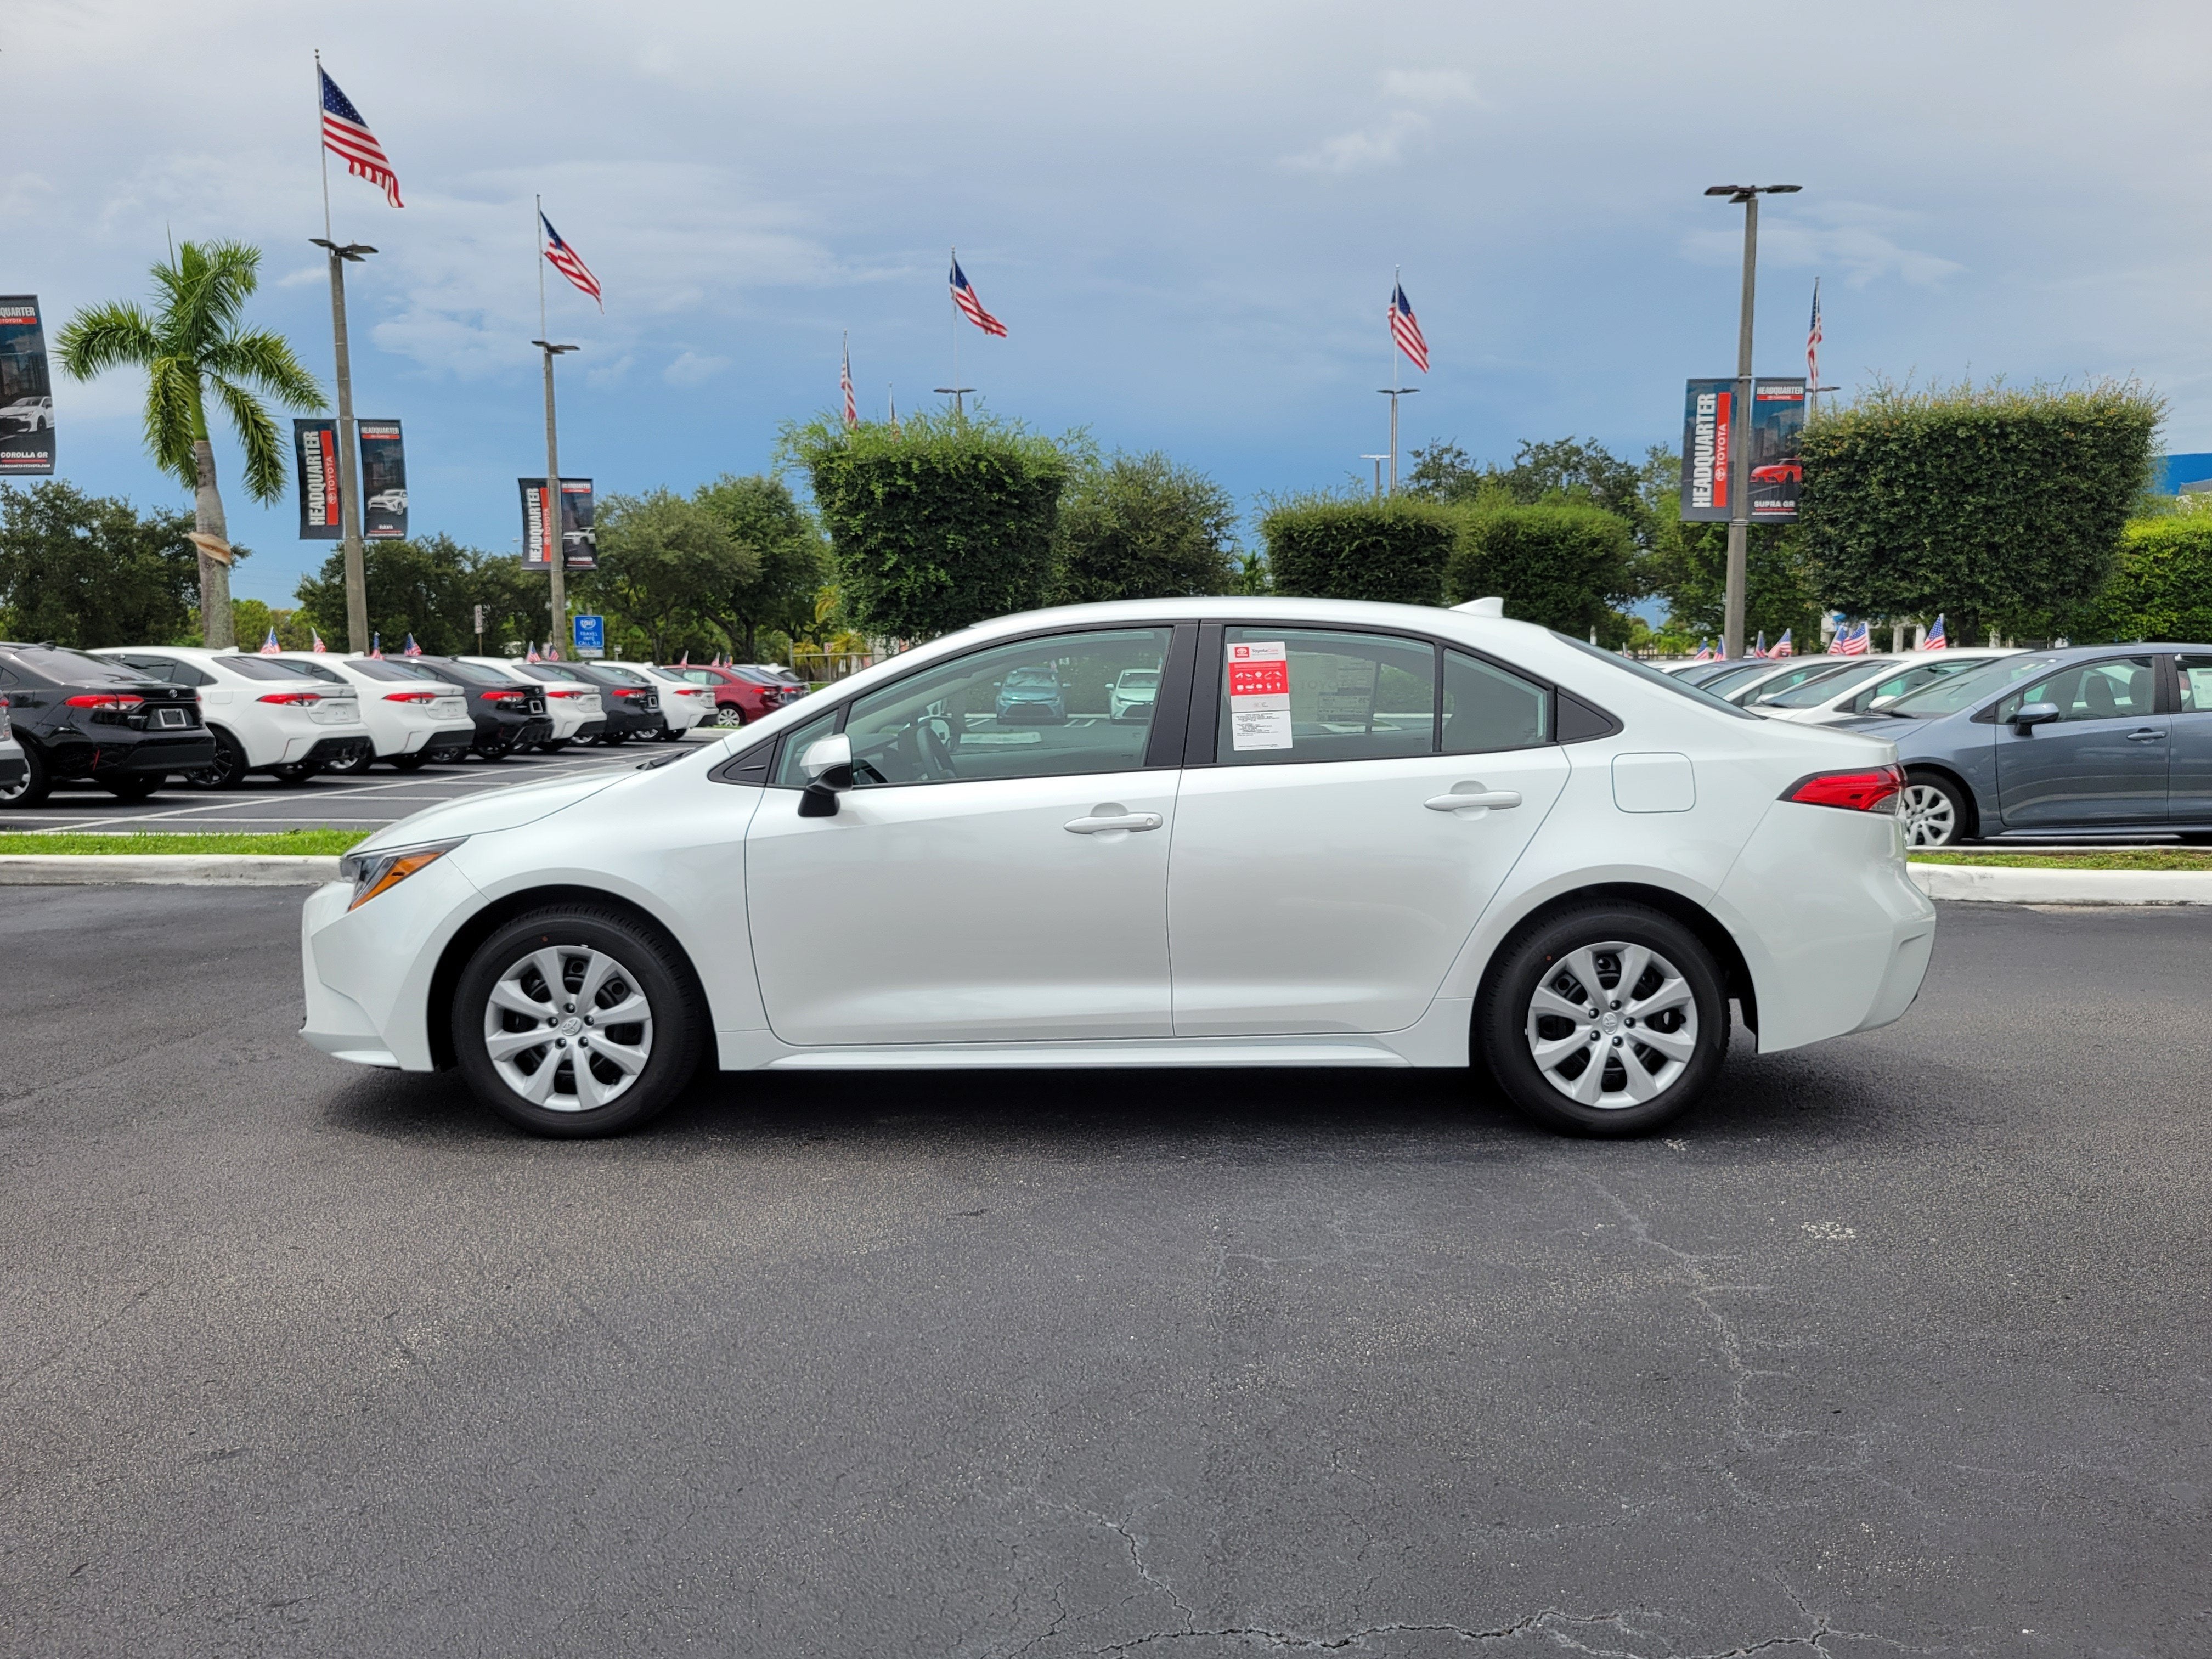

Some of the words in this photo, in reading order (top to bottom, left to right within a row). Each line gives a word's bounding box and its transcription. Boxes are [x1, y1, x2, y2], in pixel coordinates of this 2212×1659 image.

[0, 307, 36, 318] QUARTER
[1757, 386, 1803, 395] HEADQUARTER
[1692, 393, 1717, 507] HEADQUARTER
[1717, 423, 1728, 465] TOYOTA
[303, 431, 326, 526] HEADQUARTER
[326, 456, 335, 491] TOYOTA
[526, 488, 544, 562] HEADQUARTER
